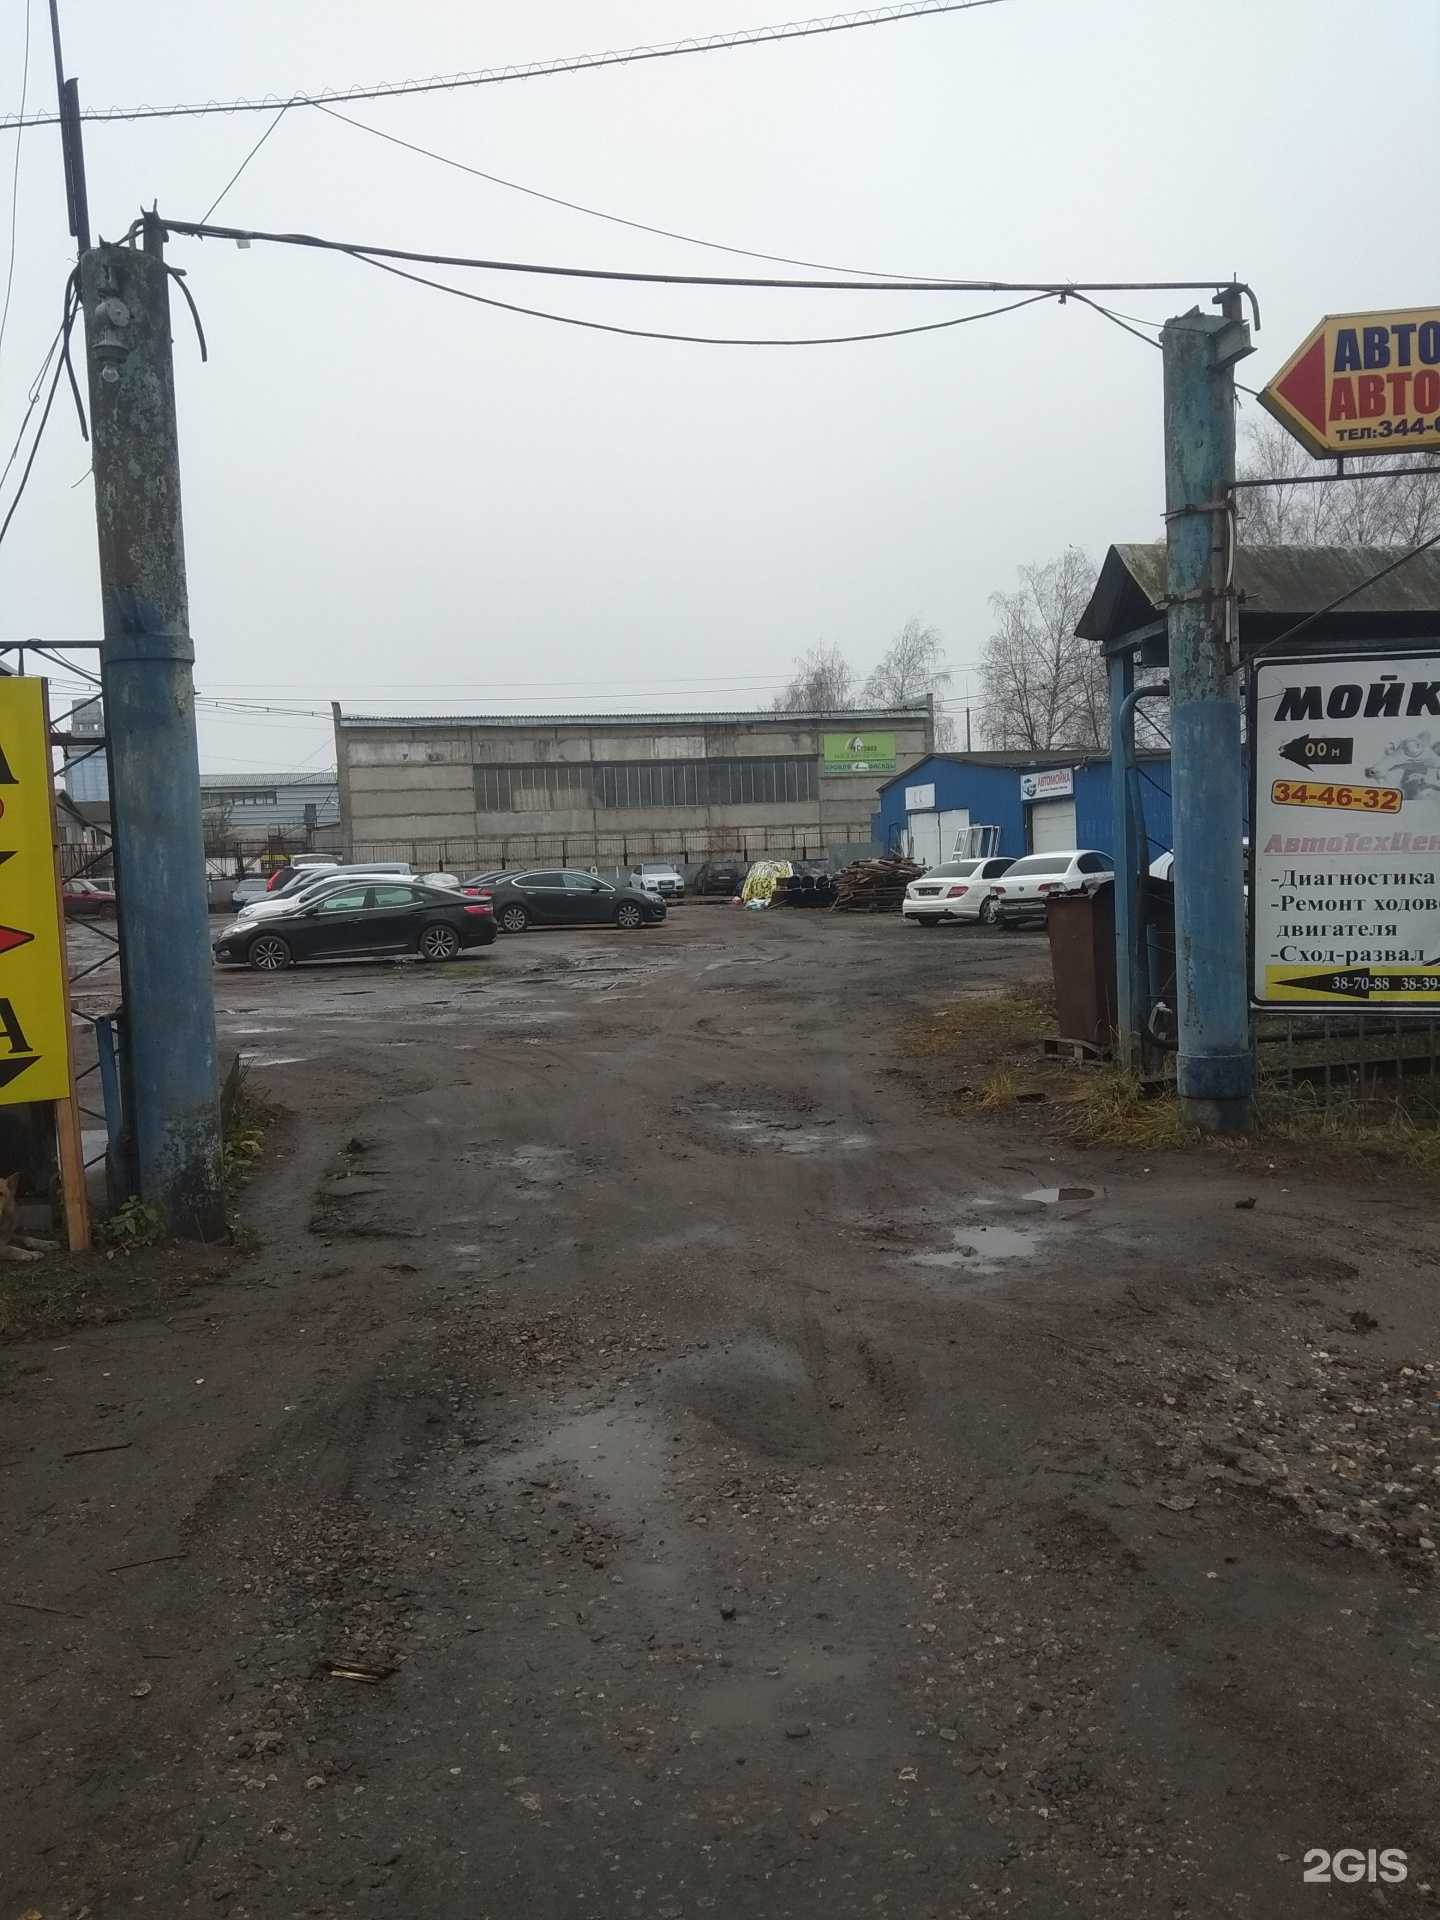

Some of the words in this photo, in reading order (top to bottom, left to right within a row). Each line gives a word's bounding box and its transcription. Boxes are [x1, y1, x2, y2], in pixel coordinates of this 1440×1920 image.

[1333, 320, 1440, 372] АВТО
[1328, 369, 1440, 421] АВТО
[1274, 675, 1440, 721] МОЙК
[1274, 783, 1398, 810] 34-46-32
[1271, 870, 1435, 889] -Диагностика
[1271, 895, 1366, 912] -Ремонт
[1374, 897, 1440, 912] ходов
[1276, 923, 1398, 938] двигателя
[1271, 945, 1425, 966] -Сход-развал
[1331, 976, 1390, 990] 38-70-88
